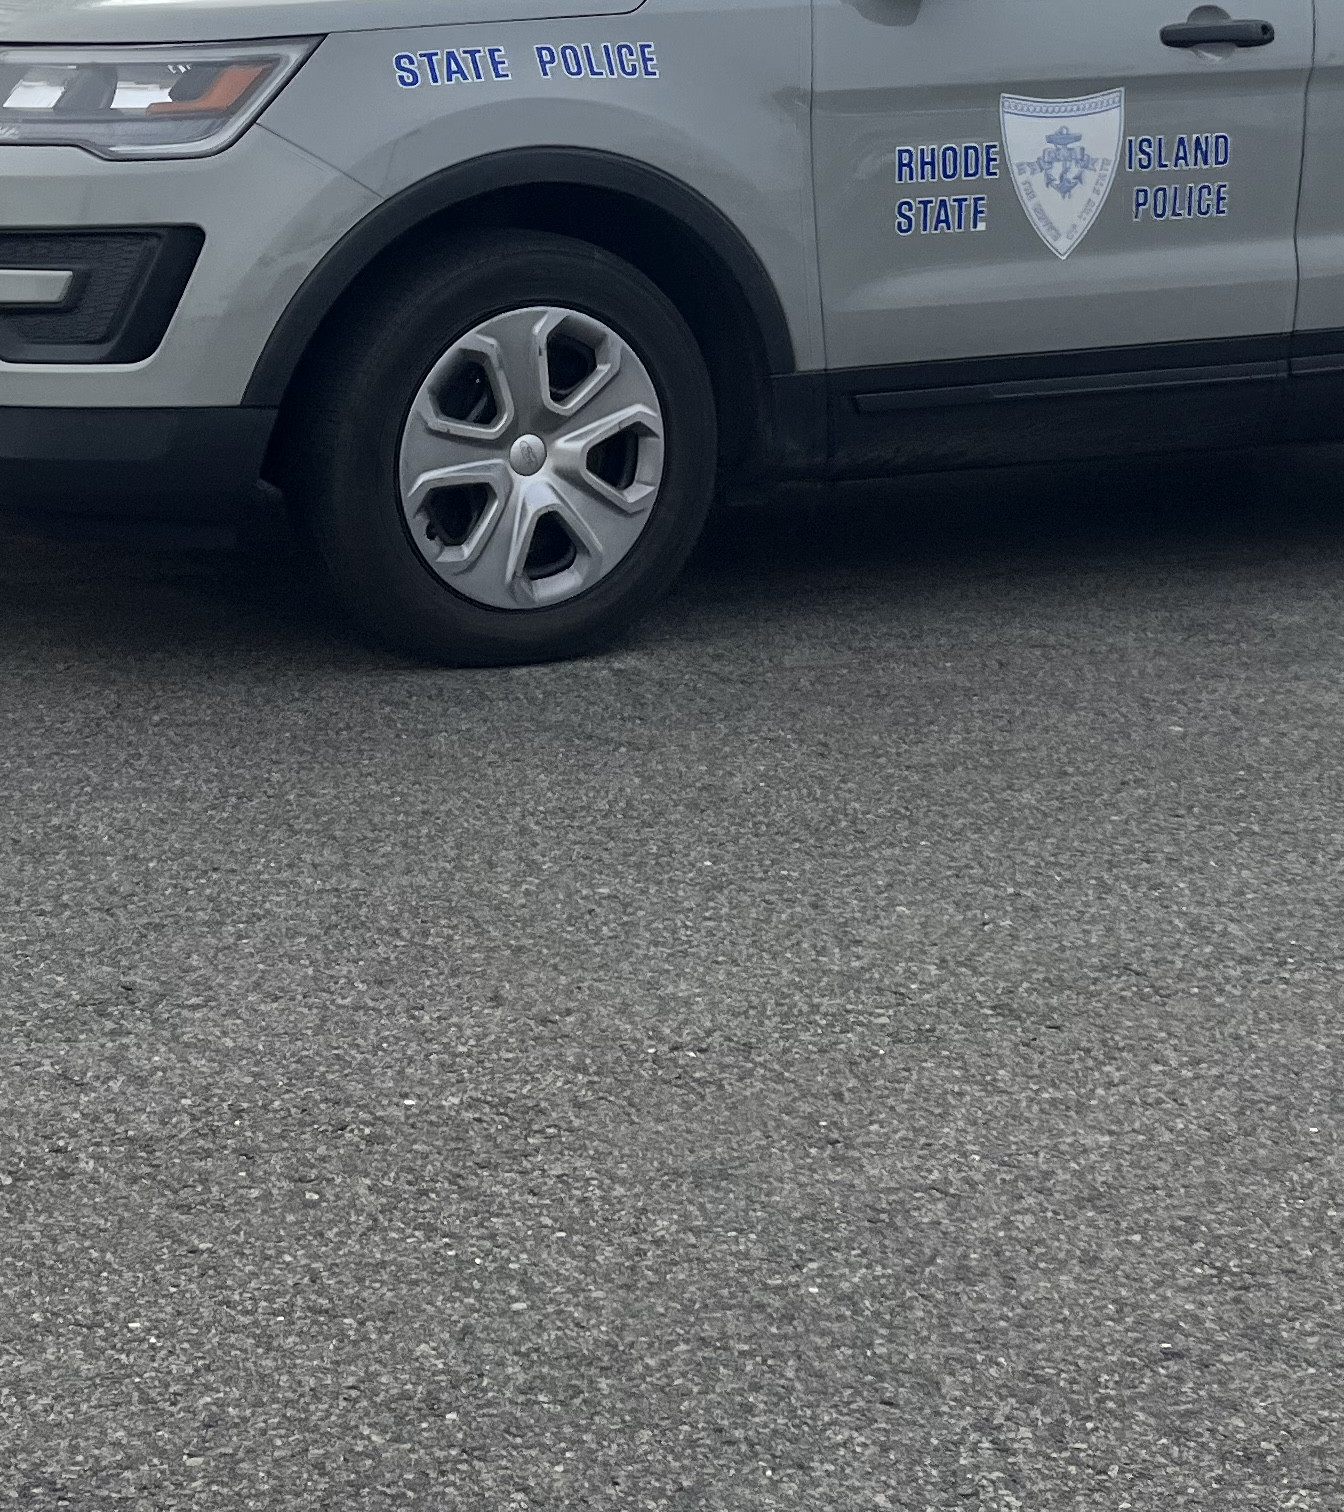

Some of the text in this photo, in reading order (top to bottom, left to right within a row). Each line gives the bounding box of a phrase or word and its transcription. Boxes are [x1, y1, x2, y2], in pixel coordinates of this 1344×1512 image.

[393, 41, 660, 89] STATE POLICE
[895, 132, 1230, 183] RHODE ISLAND
[895, 194, 987, 236] STATE
[1133, 182, 1229, 222] POLICE
